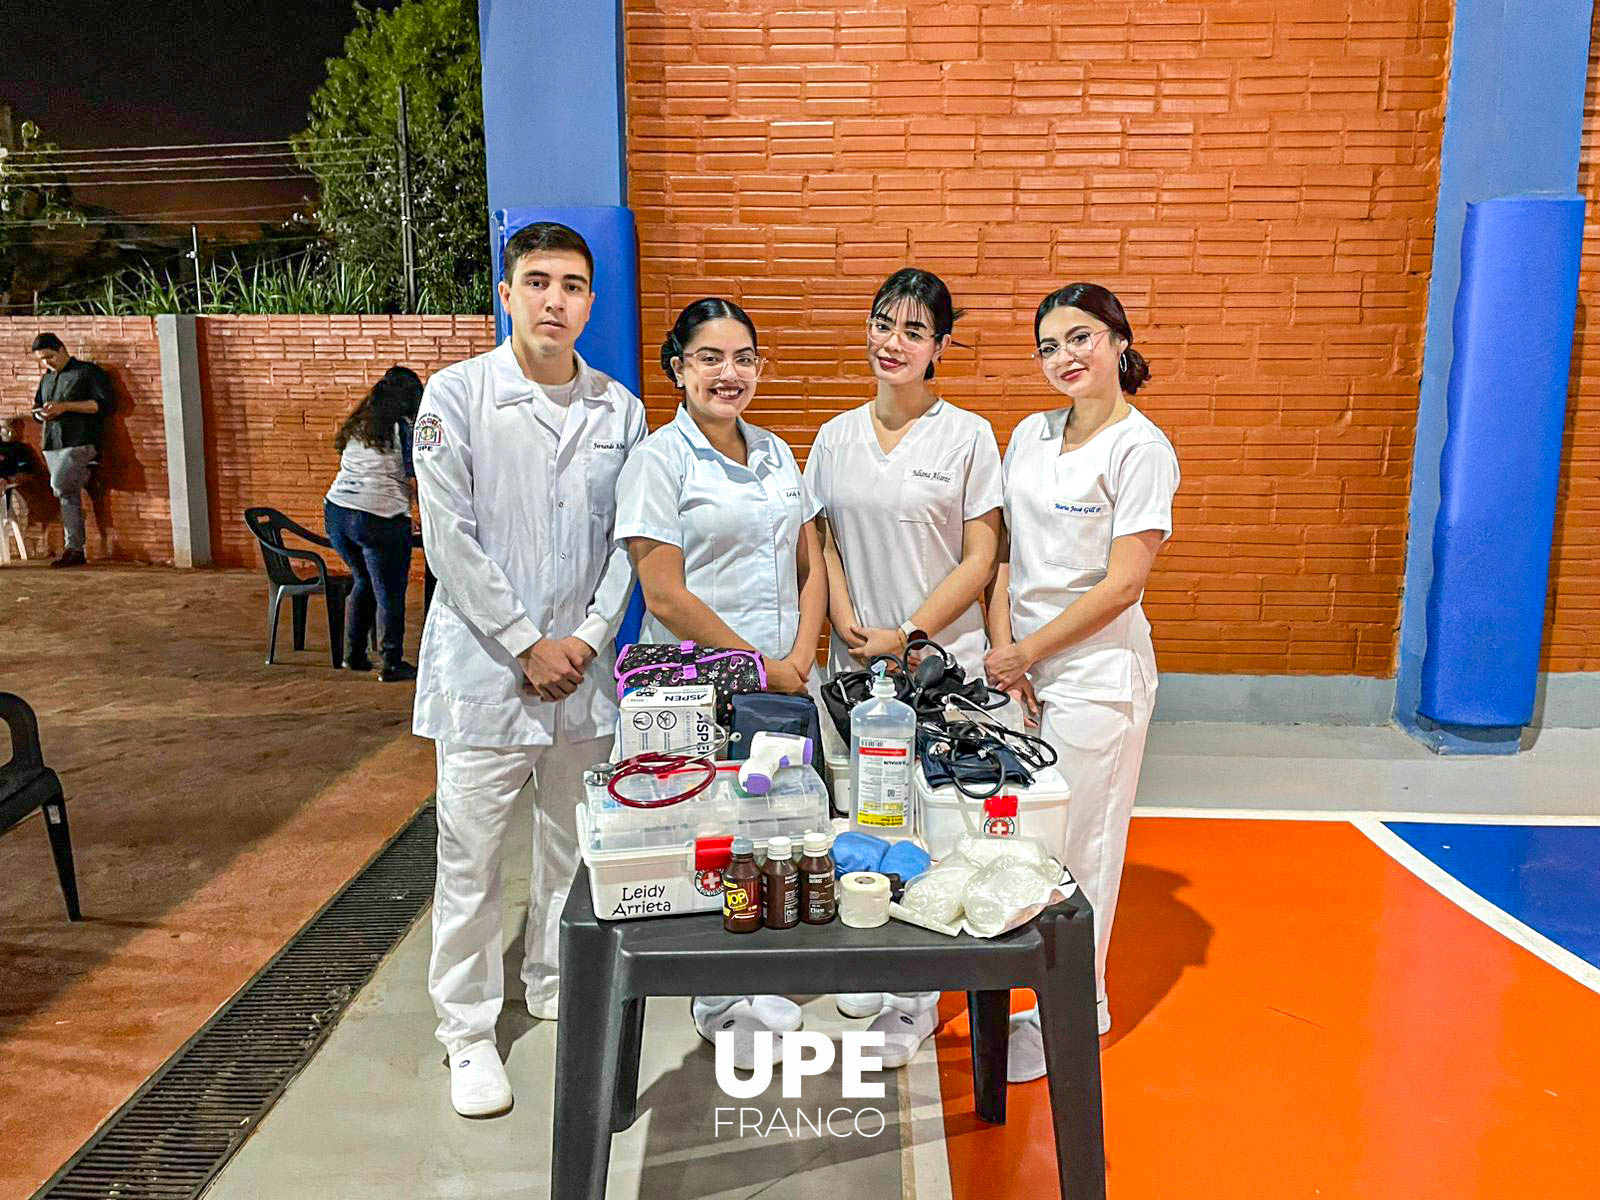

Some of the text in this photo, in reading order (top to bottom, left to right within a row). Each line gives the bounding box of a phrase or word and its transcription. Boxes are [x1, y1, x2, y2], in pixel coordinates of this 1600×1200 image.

[912, 469, 931, 478] Juliana
[622, 884, 666, 902] Leidy
[611, 901, 671, 917] Arrieta
